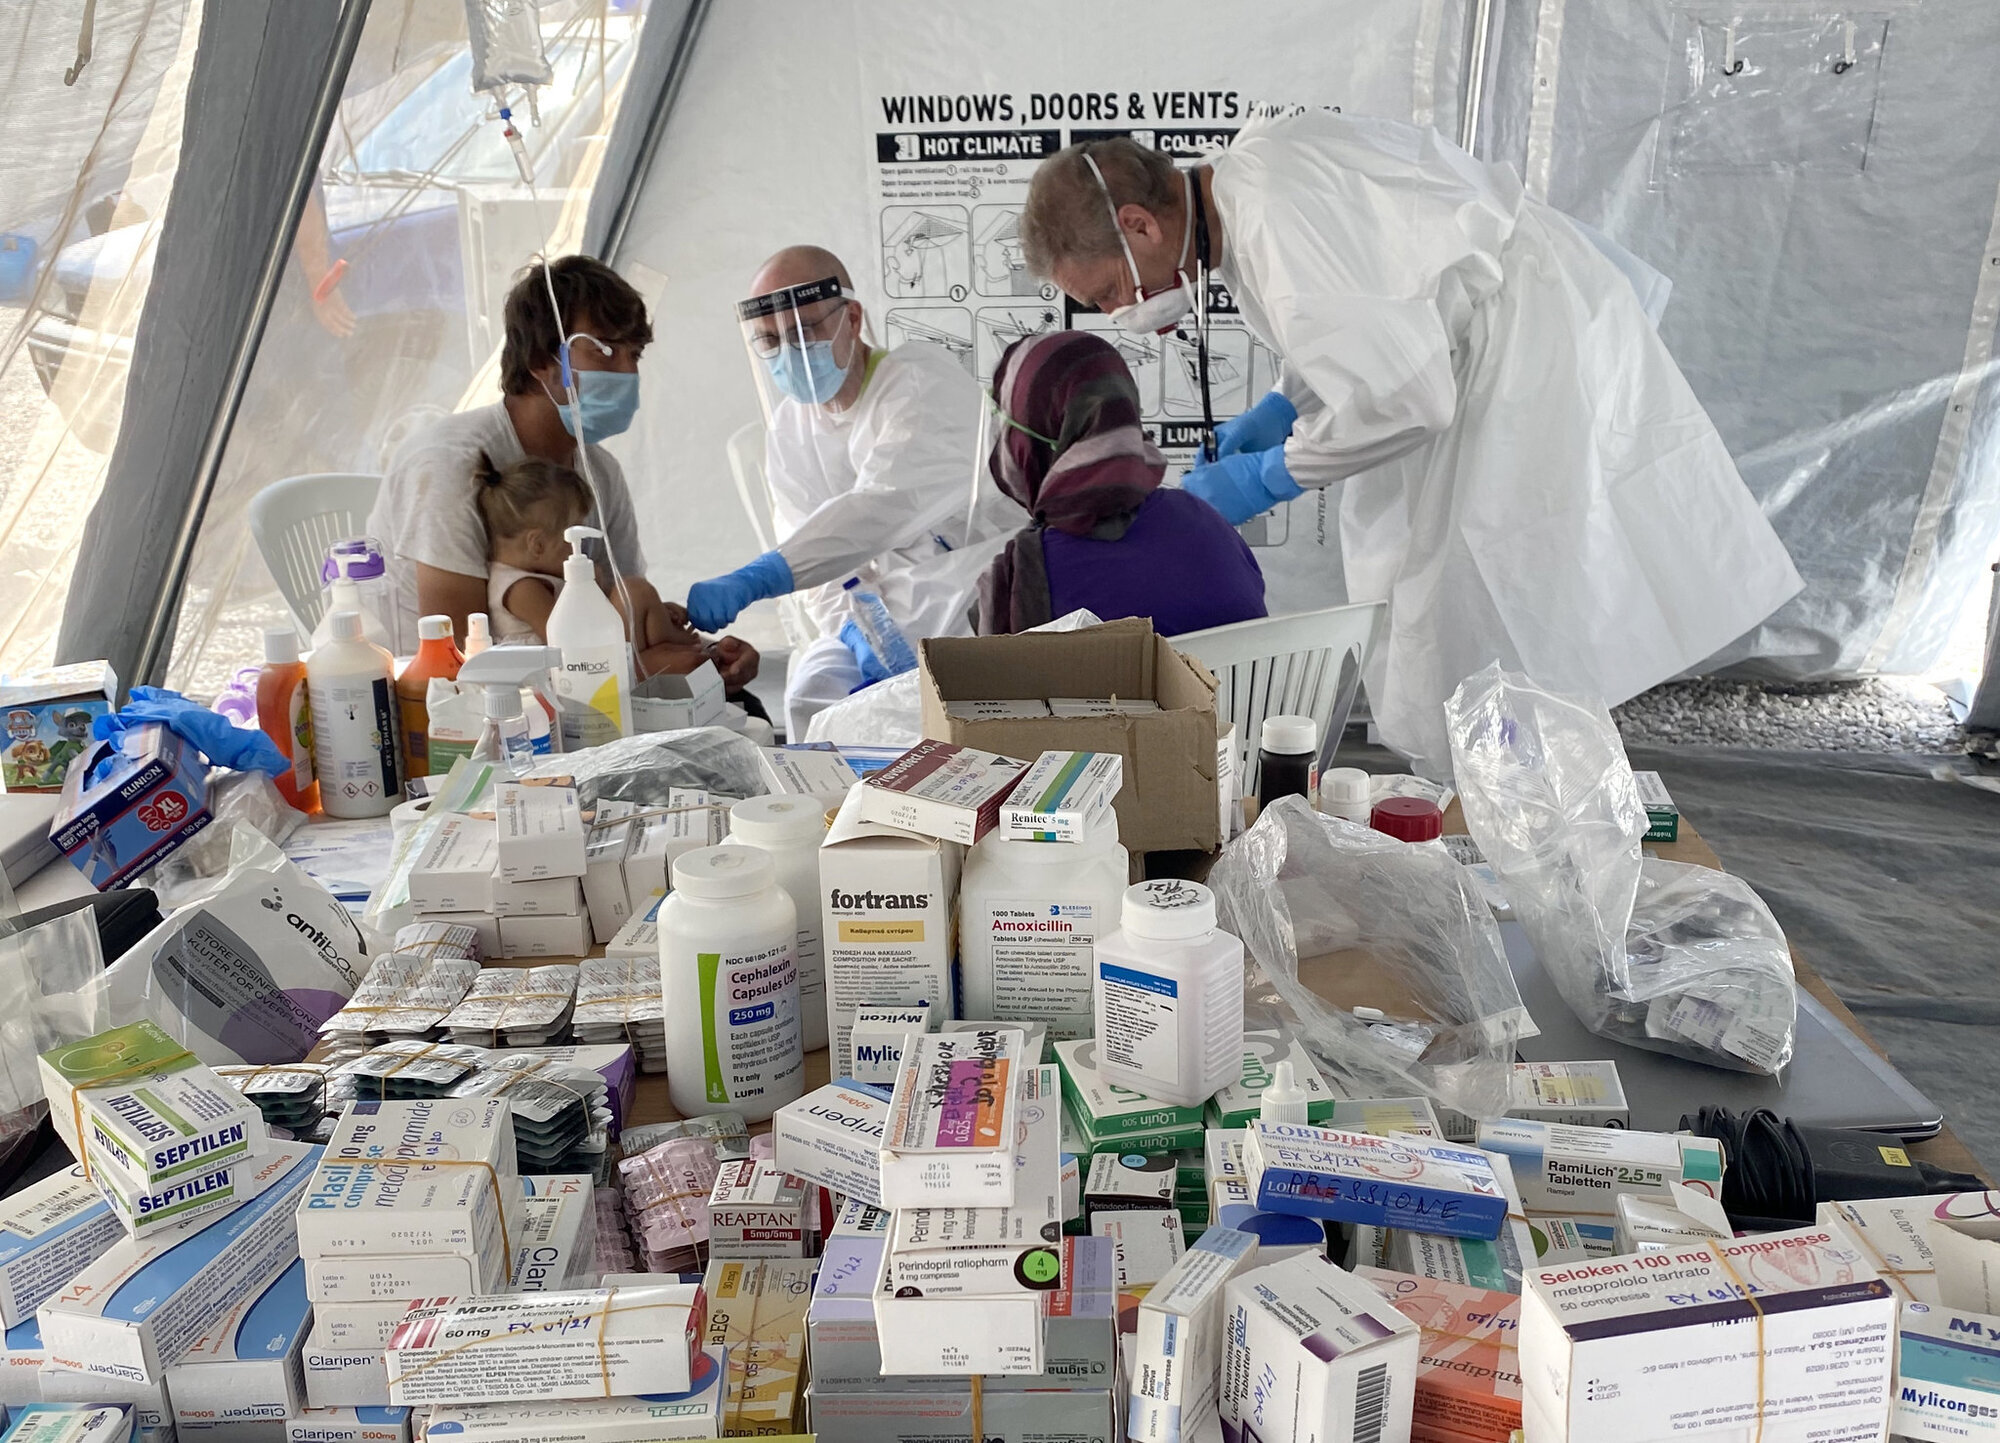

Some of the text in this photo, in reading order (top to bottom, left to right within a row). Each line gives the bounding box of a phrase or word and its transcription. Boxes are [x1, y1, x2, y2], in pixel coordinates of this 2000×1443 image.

[1127, 91, 1146, 120] &
[1153, 91, 1239, 119] VENTS
[924, 135, 1042, 156] HOT CLIMATE
[121, 766, 162, 798] KLINION
[157, 797, 180, 815] XL
[81, 812, 97, 825] long
[1011, 812, 1069, 826] Renitec mg
[123, 840, 176, 881] examination gloves
[831, 889, 928, 909] fortrans
[992, 920, 1073, 932] Amoxicillin
[195, 929, 236, 961] STORE
[187, 937, 231, 974] KLUTER
[230, 970, 255, 992] FOR
[731, 959, 791, 984] Cephalexin
[732, 968, 797, 1000] Capsules USP
[734, 1005, 771, 1021] 250 mg
[860, 1014, 923, 1024] Mylicon
[730, 1026, 773, 1041] Each capsule
[734, 1072, 761, 1083] Rx only
[734, 1087, 764, 1098] LUPIN
[836, 1093, 873, 1110] 500mg
[106, 1094, 175, 1142] SEPTILEN
[1122, 1112, 1177, 1126] LQuin 500
[154, 1123, 245, 1170] SEPTILEN
[1140, 1136, 1177, 1148] LQuin
[254, 1154, 293, 1182] 500mg
[308, 1124, 377, 1210] Plasil 10 mg
[1281, 1163, 1337, 1173] MENARINI
[1548, 1161, 1663, 1182] RamiLich 2,5 mg
[560, 1178, 582, 1195] 14
[1548, 1173, 1612, 1190] Tabletten
[138, 1170, 231, 1214] SEPTILEN
[1546, 1187, 1576, 1196] Ramipril
[713, 1212, 793, 1227] REAPTAN
[750, 1230, 793, 1239] 5mg/5mg
[899, 1258, 1008, 1271] Perindopril ratiopharm
[1539, 1231, 1832, 1287] Seloken 100 mg compresse
[920, 1272, 959, 1280] compresse
[1552, 1266, 1711, 1300] metoprololo tartrato
[60, 1284, 93, 1304] 14
[1560, 1292, 1651, 1312] 50 compresse
[709, 1314, 730, 1333] EG
[445, 1328, 491, 1341] 60 mg
[1838, 1334, 1886, 1347] AstraZeneca
[308, 1355, 372, 1367] Claripen
[1223, 1313, 1236, 1402] Novaminsulfon
[91, 1362, 145, 1385] Claripen
[1048, 1364, 1089, 1375] sigma
[1230, 1320, 1245, 1422] Lichtenstein 500
[1240, 1346, 1252, 1400] Tabletten
[1140, 1364, 1150, 1396] Ramipril
[1148, 1370, 1157, 1398] Zentiva
[1162, 1359, 1172, 1401] compresse
[1594, 1391, 1621, 1400] LOTTO
[179, 1406, 286, 1419] Claripen 500mg
[647, 1403, 708, 1417] TEVA
[291, 1429, 396, 1441] Claripen 500mg
[1923, 1421, 1968, 1436] SIMETICONE
